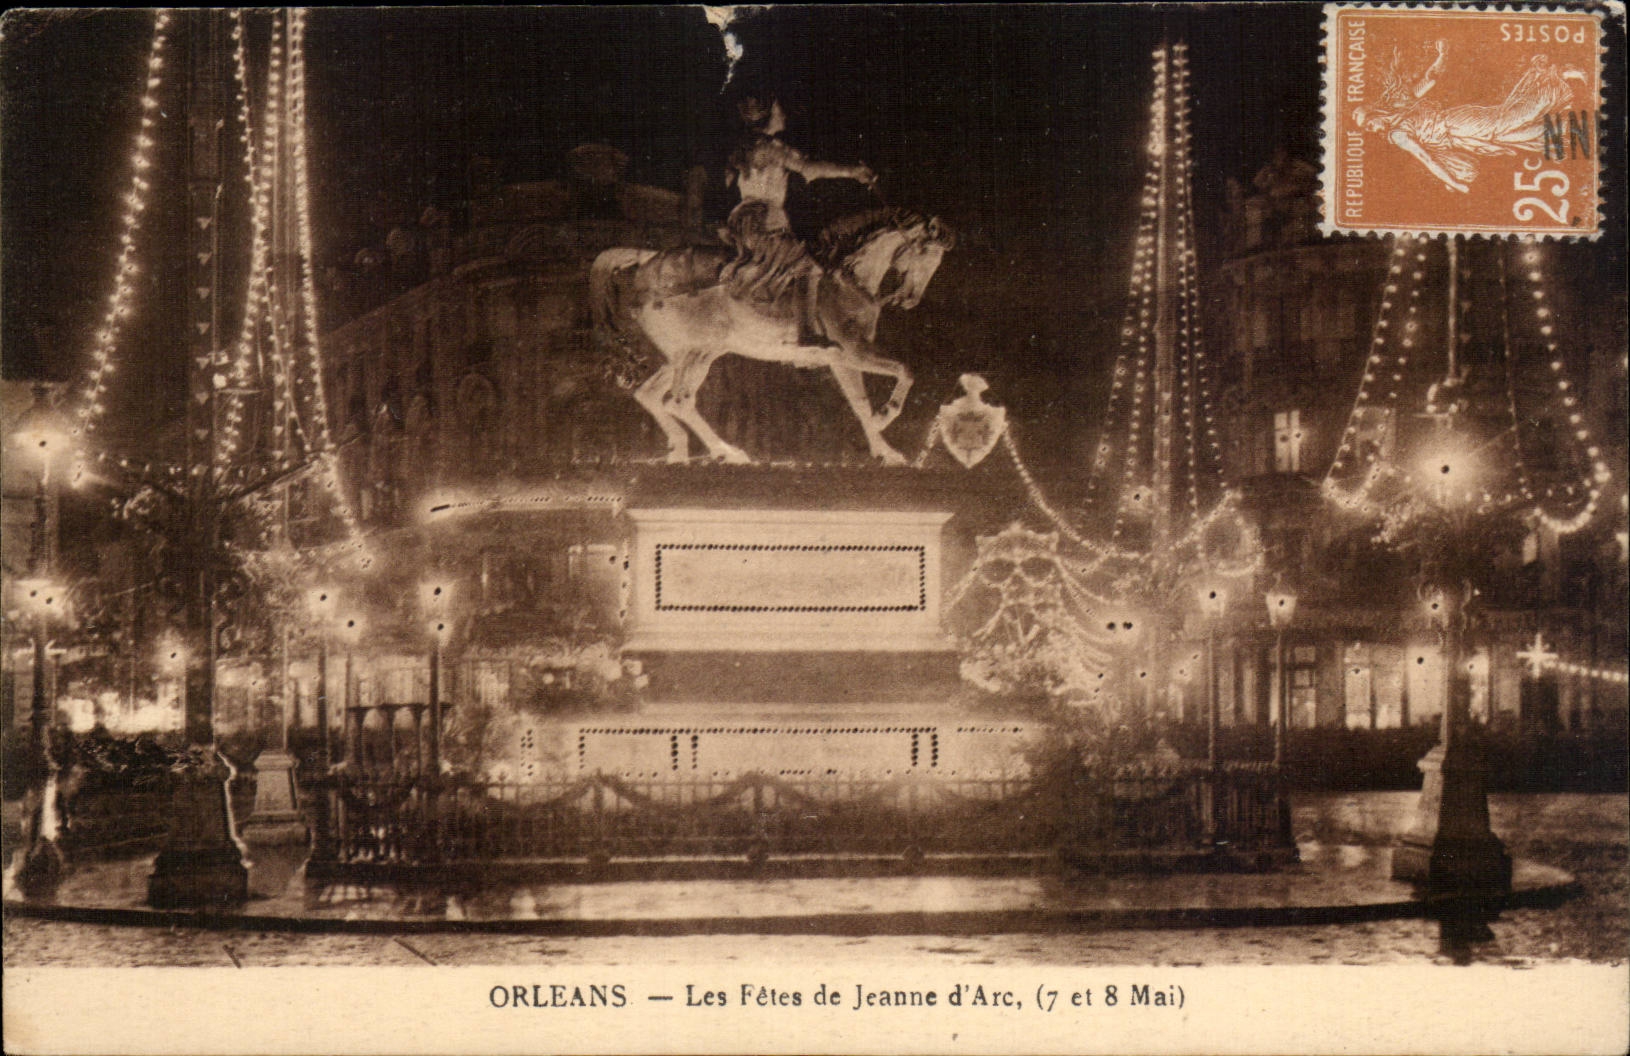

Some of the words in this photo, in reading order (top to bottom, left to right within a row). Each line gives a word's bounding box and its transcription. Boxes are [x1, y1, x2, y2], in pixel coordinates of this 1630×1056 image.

[1347, 19, 1366, 103] FRANÇAISE
[1501, 22, 1585, 44] POSTES
[1345, 129, 1365, 218] REPUBLIQUE
